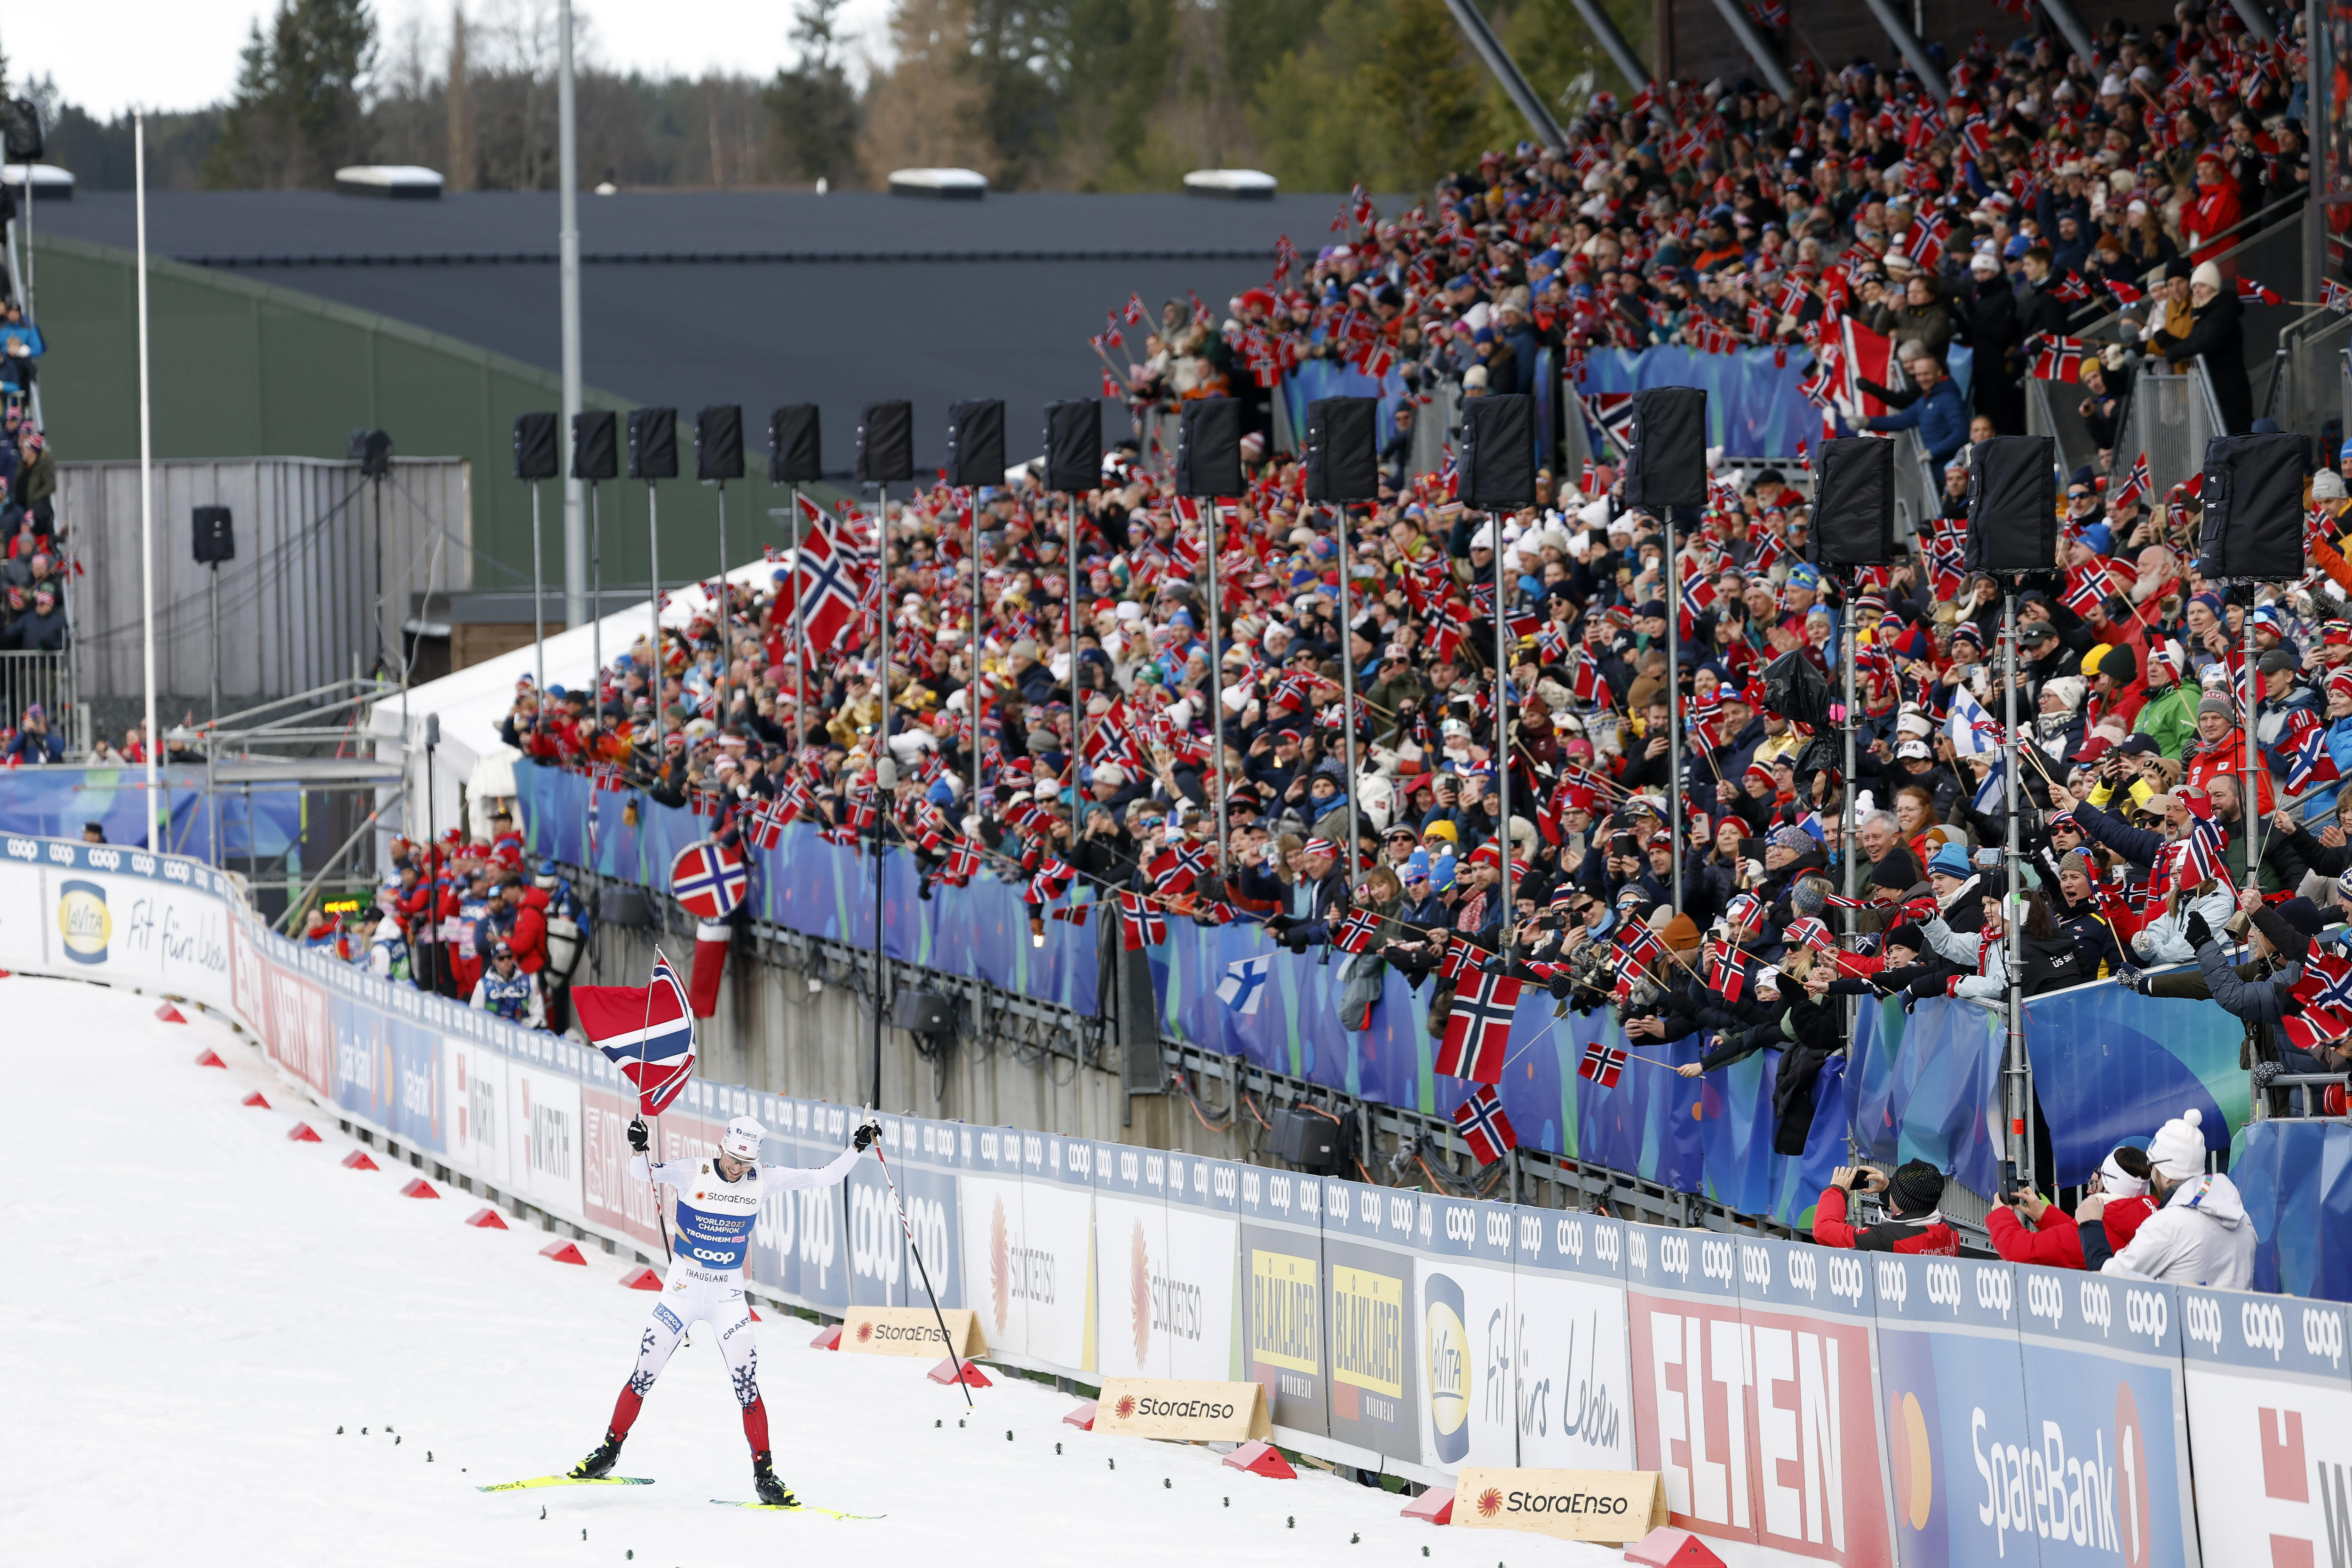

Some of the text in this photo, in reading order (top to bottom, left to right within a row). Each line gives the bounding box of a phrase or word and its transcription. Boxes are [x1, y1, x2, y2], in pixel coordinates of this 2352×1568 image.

[7, 838, 38, 862] coop
[49, 843, 74, 867] coop
[88, 848, 120, 872] coop
[127, 896, 154, 952] Fit
[2052, 958, 2064, 968] US
[1068, 1144, 1090, 1179] coop
[1120, 1152, 1138, 1187] coop
[1146, 1155, 1164, 1192] coop
[707, 1192, 757, 1205] StoraEnso
[1215, 1167, 1236, 1205] coop
[1243, 1171, 1260, 1210] coop
[1270, 1175, 1290, 1216] coop
[1300, 1180, 1318, 1221] coop
[1328, 1186, 1350, 1226] coop
[695, 1215, 725, 1226] WORLD
[699, 1223, 739, 1234] CHAMPION
[1361, 1190, 1382, 1233] coop
[1391, 1196, 1412, 1240] coop
[1446, 1206, 1476, 1250] coop
[1487, 1210, 1510, 1256] coop
[686, 1228, 731, 1243] TRONDHEIM
[693, 1247, 735, 1265] coop
[851, 1182, 900, 1306] coop
[1521, 1215, 1542, 1260] coop
[1557, 1219, 1583, 1266] coop
[1595, 1224, 1619, 1271] coop
[1629, 1230, 1647, 1278] coop
[1944, 1244, 1956, 1254] TEAM
[686, 1268, 728, 1282] THAUGLAND
[1661, 1235, 1689, 1283] coop
[1702, 1240, 1732, 1289] coop
[1743, 1245, 1771, 1294] coop
[1788, 1250, 1817, 1300] coop
[1829, 1255, 1863, 1308] coop
[1879, 1260, 1907, 1312] coop
[1927, 1263, 1961, 1315] coop
[1976, 1267, 2011, 1321] coop
[2028, 1274, 2063, 1329] coop
[663, 1311, 681, 1329] OBOS
[663, 1317, 676, 1333] Watne
[723, 1316, 750, 1340] CRAFT
[1255, 1257, 1316, 1363] BLÅKLÄDER
[1336, 1274, 1399, 1385] BLÅKLÄDER
[2081, 1280, 2111, 1337] coop
[2126, 1288, 2167, 1347] coop
[2187, 1295, 2222, 1354] coop
[875, 1324, 952, 1343] StoraEnso
[2242, 1302, 2285, 1361] coop
[2303, 1308, 2343, 1369] coop
[1282, 1374, 1312, 1400] WORKWEAR
[1485, 1302, 1619, 1451] Fit fürs Leben
[1138, 1397, 1234, 1420] StoraEnso
[1366, 1395, 1394, 1423] WORKWEAR
[1650, 1311, 1845, 1553] ELTEN
[1507, 1491, 1628, 1516] StoraEnso
[1971, 1406, 2140, 1565] SpareBank 1
